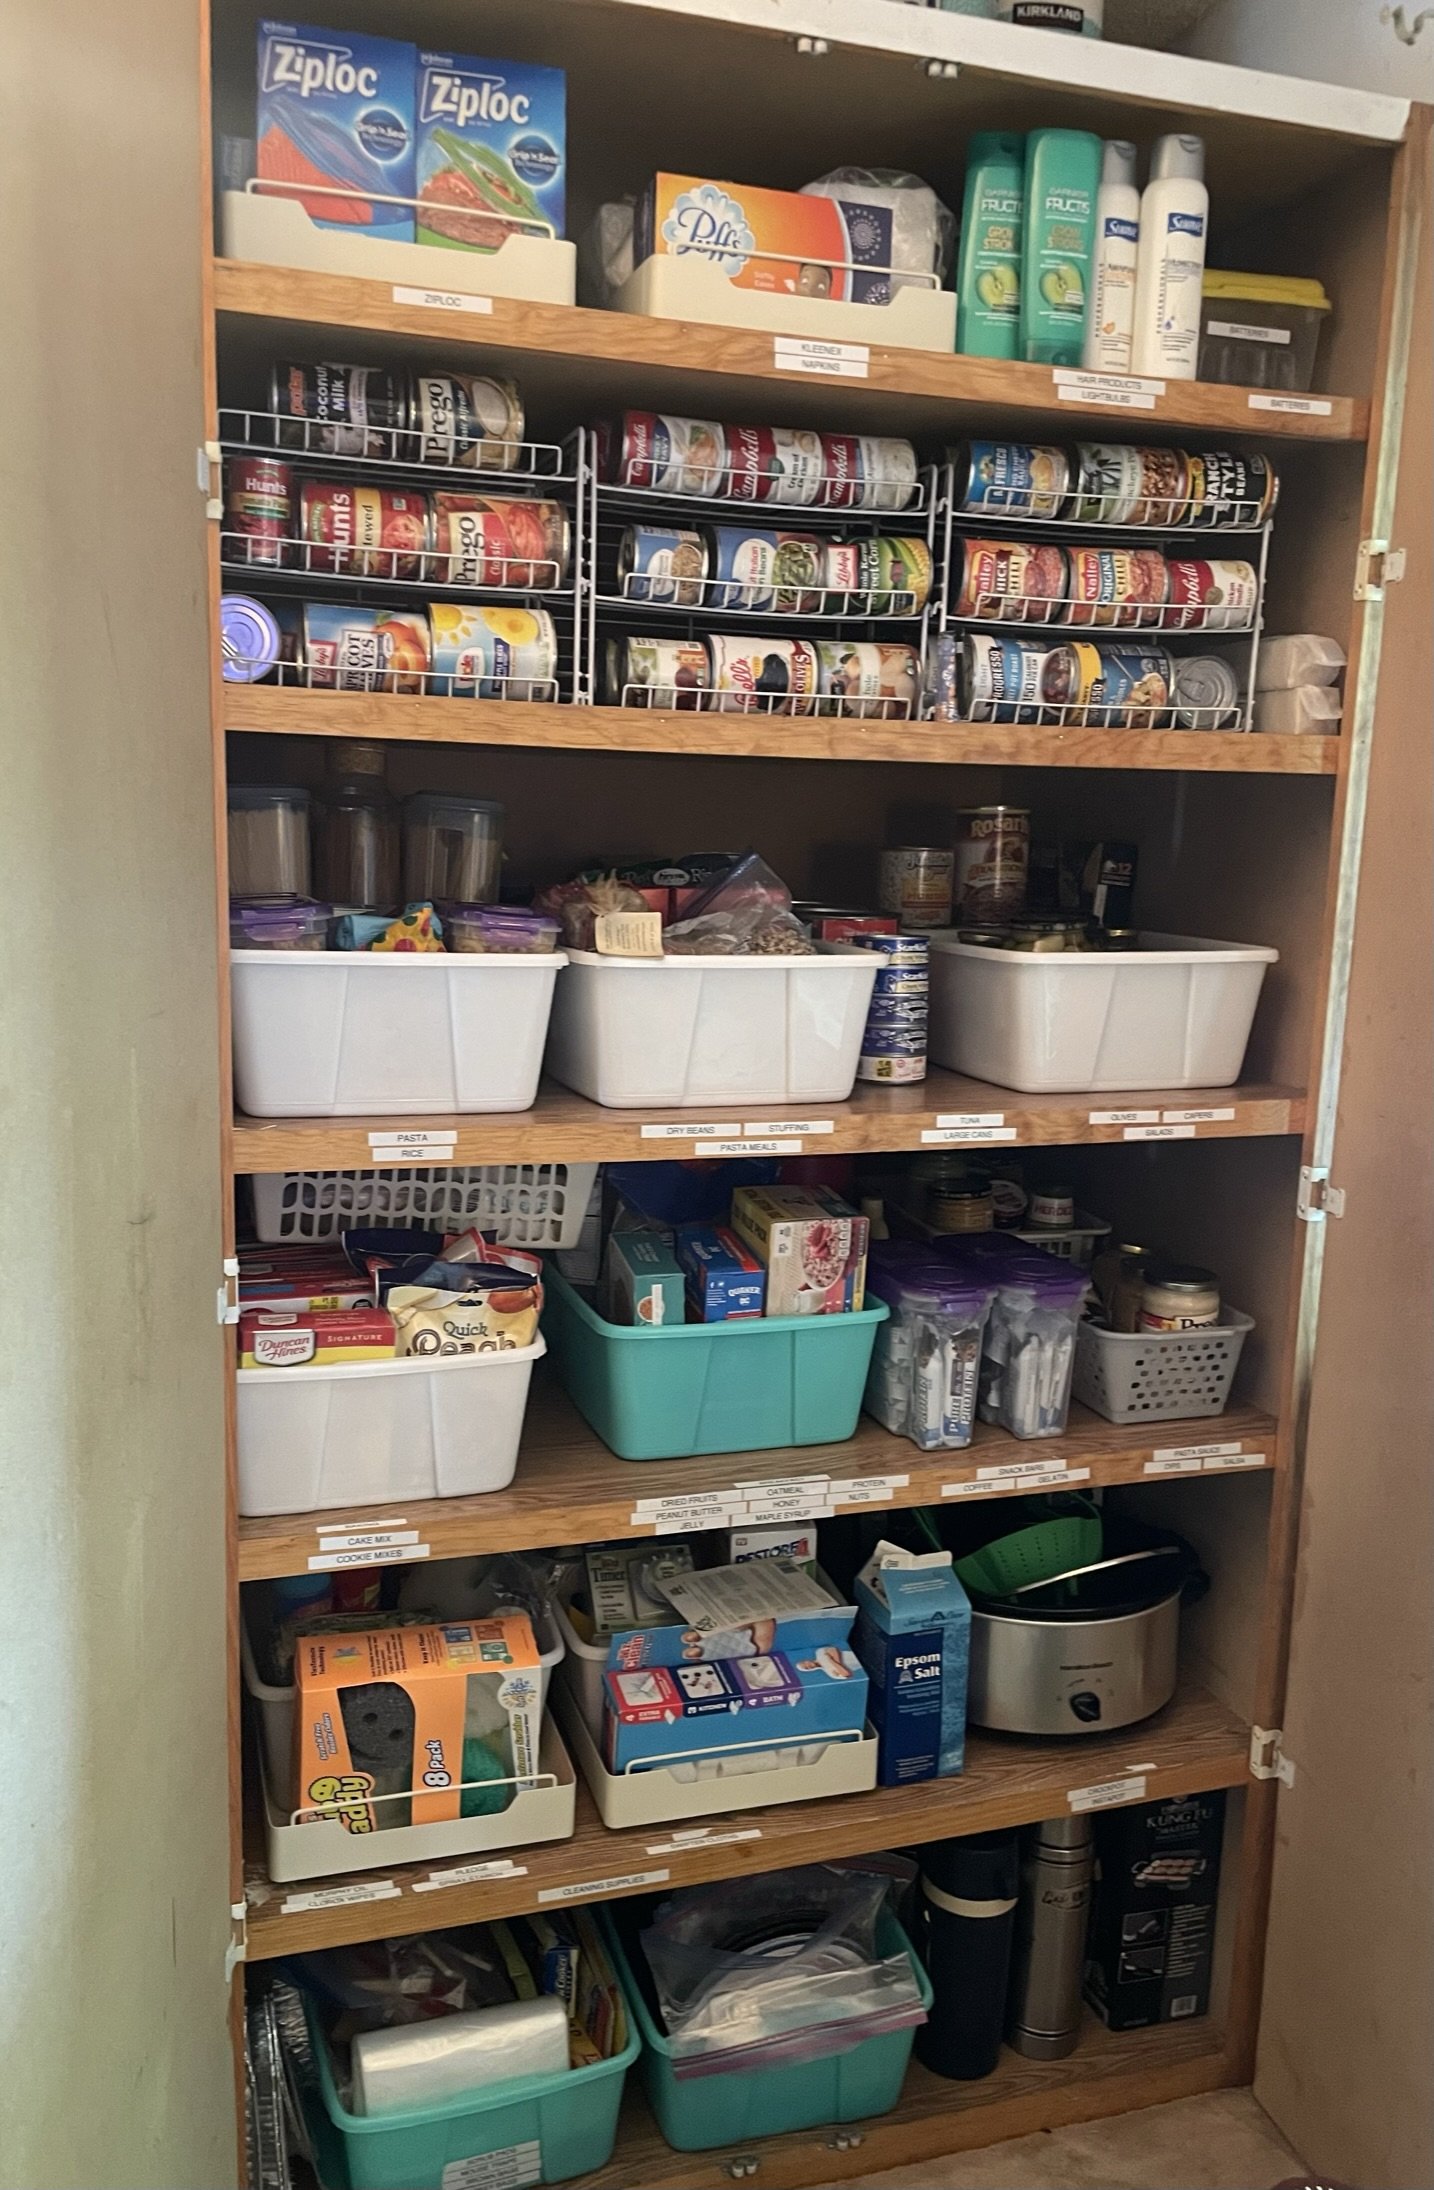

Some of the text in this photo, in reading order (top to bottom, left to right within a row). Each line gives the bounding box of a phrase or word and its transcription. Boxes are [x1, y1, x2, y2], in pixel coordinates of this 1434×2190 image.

[1015, 4, 1082, 23] KIRKLAND
[273, 44, 378, 98] Ziploc
[431, 74, 531, 127] Ziploc
[1045, 197, 1090, 214] FRUCTIS
[424, 294, 462, 308] ZIPLOC
[1229, 325, 1269, 338] BATTERIES
[801, 343, 842, 356] KLEENEX
[801, 359, 841, 372] NAPKINS
[1076, 374, 1142, 390] HAIR PRODUCTS
[315, 366, 328, 424] Coconut
[330, 380, 345, 412] Milk
[1081, 390, 1131, 404] LIGHTBULBS
[1270, 399, 1311, 411] BATTERIES
[424, 382, 454, 455] Prego
[733, 429, 760, 499] Campbell's
[828, 444, 852, 505] Campbell's
[1203, 453, 1220, 506] RANCH
[1235, 462, 1246, 496] BEANS
[362, 505, 375, 546] tewed
[454, 516, 484, 583] Prego
[859, 543, 869, 568] Kernel
[868, 540, 880, 564] Corn
[996, 561, 1008, 593] HICK
[1084, 555, 1099, 599] Nalley
[1099, 555, 1114, 602] ORIGINAL
[1115, 559, 1127, 596] CHILI
[1174, 562, 1202, 626] Campbell's
[313, 648, 328, 680] Liby's
[346, 634, 360, 691] APRCOT
[794, 654, 810, 692] OLIVES
[989, 650, 1004, 704] PROGRESSO
[864, 673, 874, 698] hole
[1022, 682, 1036, 702] 150
[960, 1116, 980, 1125] TUNA
[1111, 1113, 1137, 1121] OLIVES
[667, 1126, 715, 1136] DRY BEANS
[768, 1123, 809, 1133] STUFFING
[944, 1129, 993, 1139] LARGE CANS
[397, 1133, 428, 1143] PASTA
[401, 1149, 424, 1158] RICE
[720, 1141, 777, 1153] PASTA MEALS
[728, 1286, 761, 1297] QUAKER
[443, 1321, 488, 1337] Quick
[258, 1335, 310, 1353] Duncan
[327, 1334, 383, 1343] SIGNATURE
[272, 1345, 307, 1359] Hines
[962, 1369, 974, 1425] PROTEIN
[948, 1397, 962, 1433] PURE
[1174, 1448, 1198, 1456] PASTA
[999, 1463, 1045, 1475] SNACK BARS
[852, 1479, 886, 1488] PROTEIN
[1038, 1473, 1069, 1484] GELATIN
[767, 1486, 804, 1496] OATMEAL
[963, 1482, 993, 1492] COFFEE
[661, 1494, 718, 1507] DRIED FRUITS
[772, 1498, 800, 1508] HONEY
[848, 1492, 870, 1501] NUTS
[656, 1506, 723, 1521] PEANUT BUTTER
[755, 1509, 811, 1522] MAPLE SYRUP
[680, 1520, 704, 1530] JELLY
[347, 1534, 392, 1546] CAKE MIX
[336, 1549, 403, 1563] COOKIE MIXES
[895, 1653, 941, 1669] Epsom
[914, 1666, 941, 1679] Salt
[423, 1739, 451, 1787] 8 Pack
[455, 1865, 489, 1875] PLEDGE
[562, 1875, 645, 1896] CLEANING SUPPLIES
